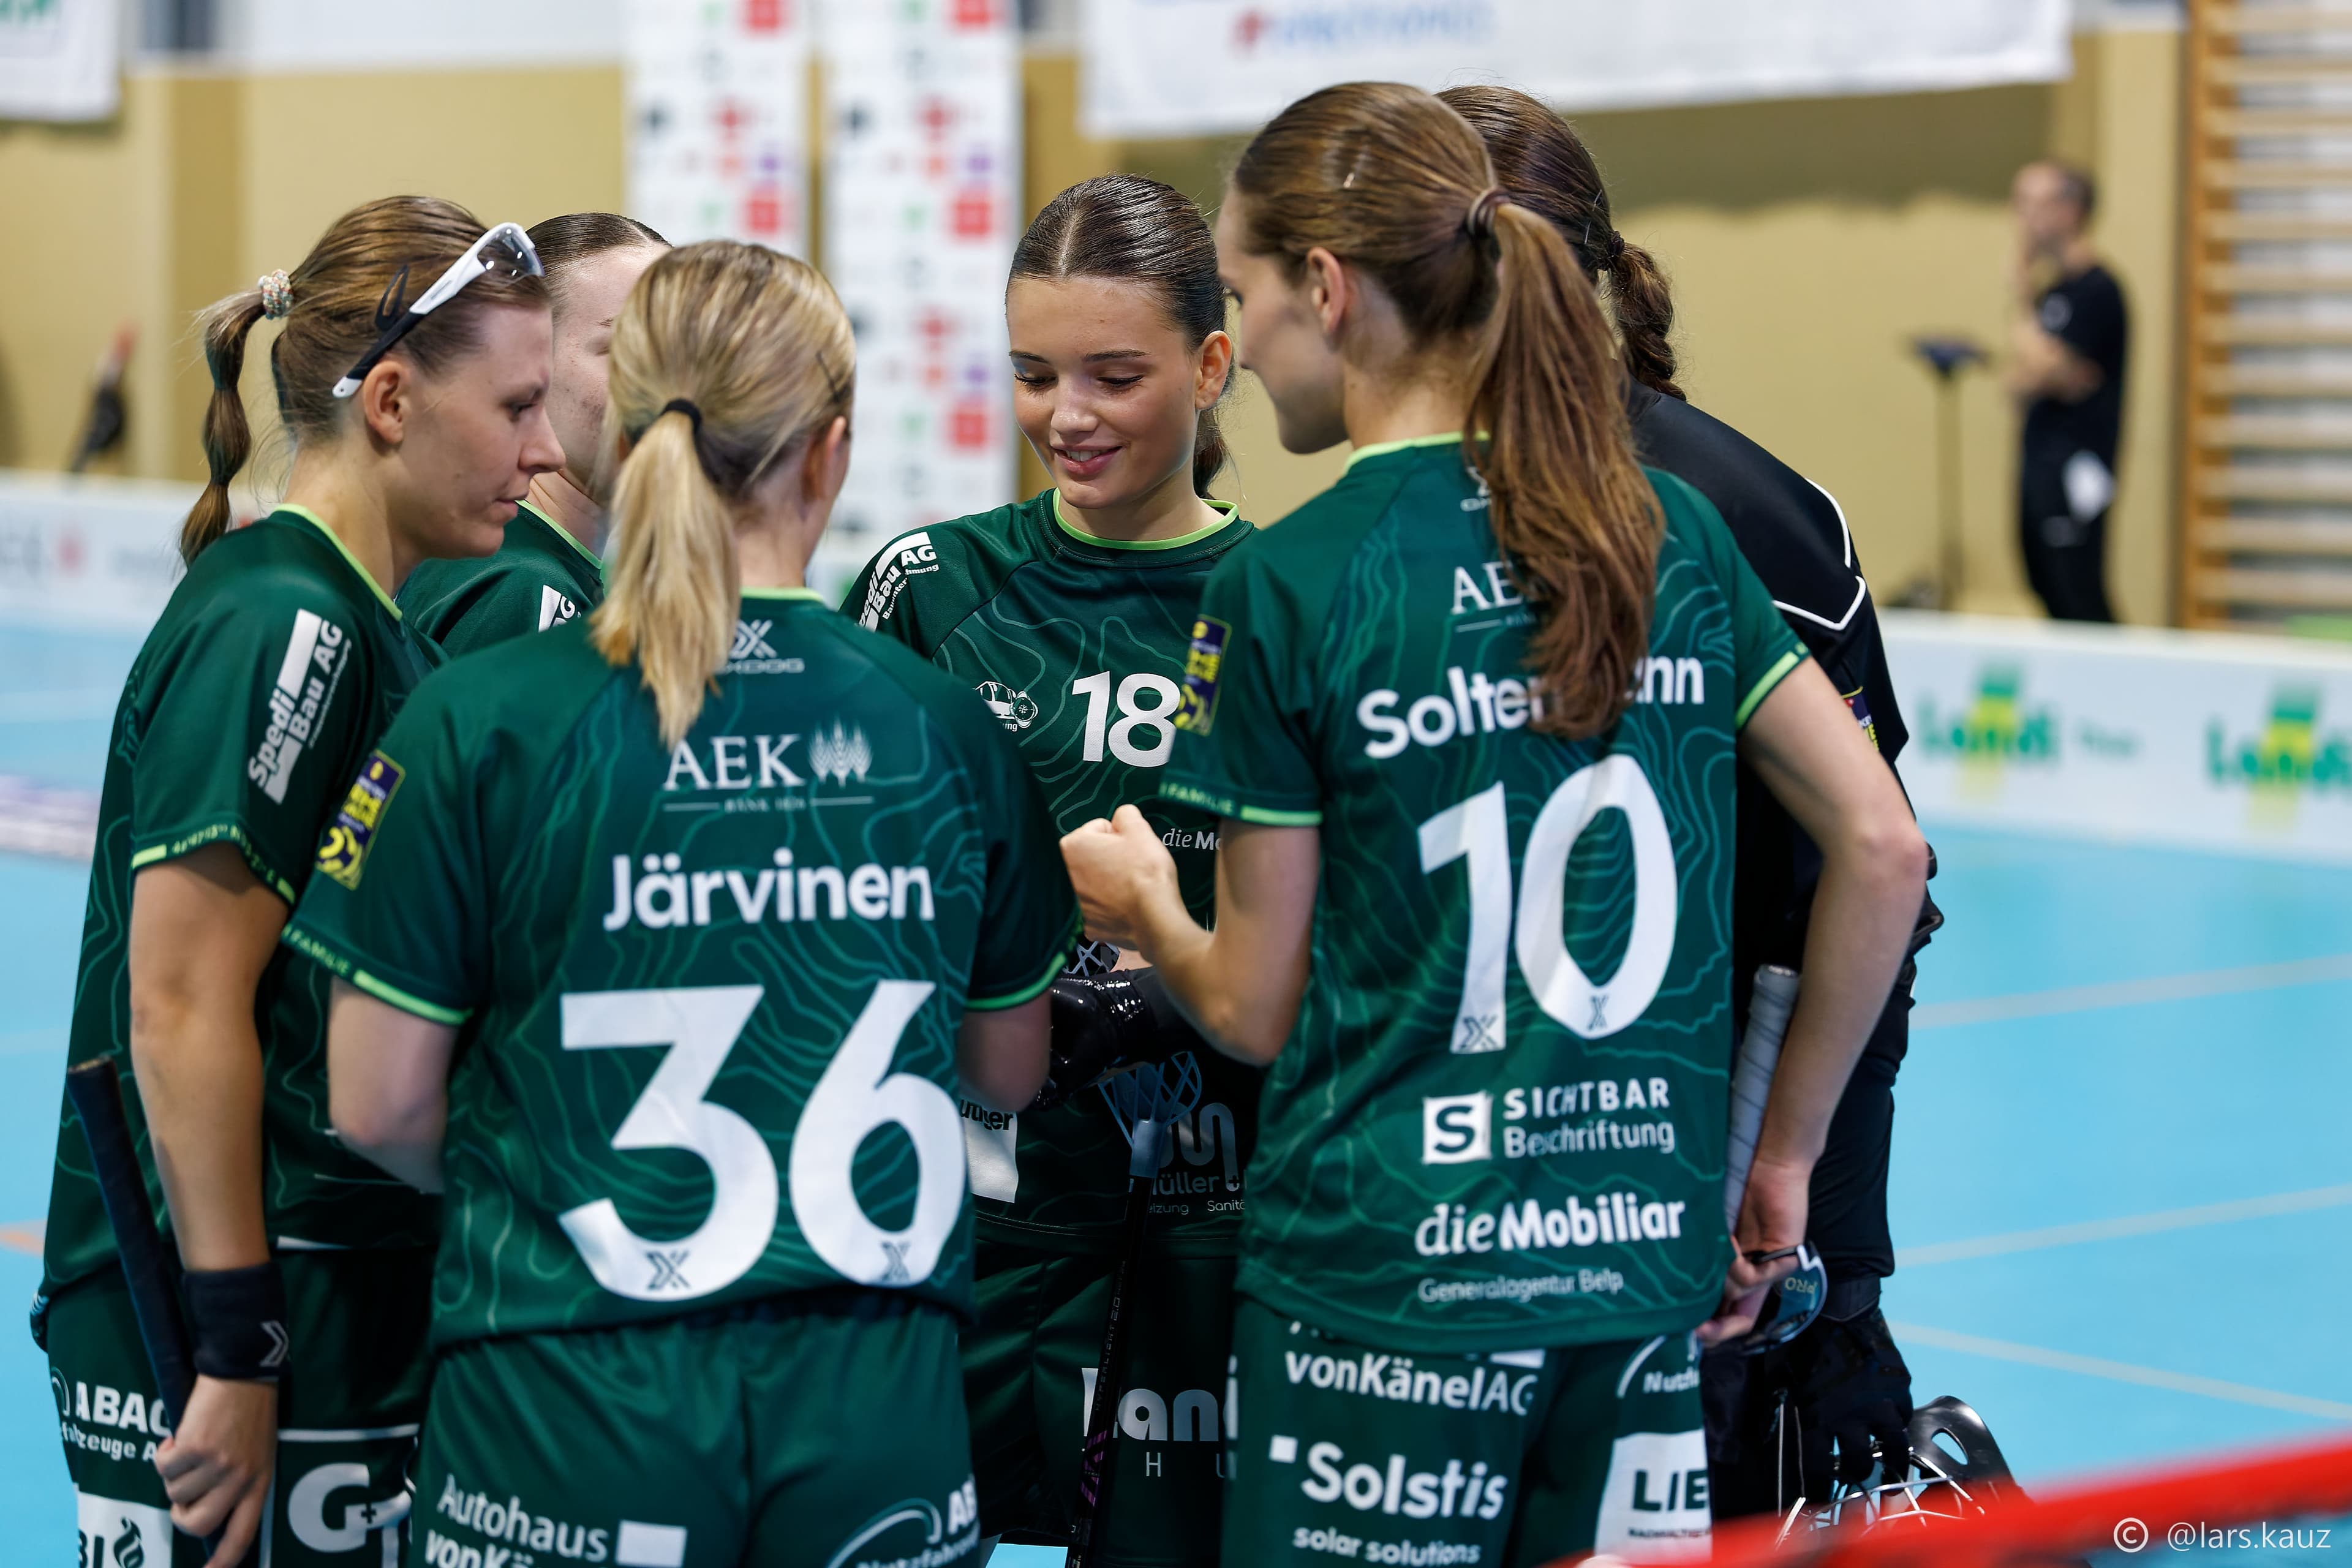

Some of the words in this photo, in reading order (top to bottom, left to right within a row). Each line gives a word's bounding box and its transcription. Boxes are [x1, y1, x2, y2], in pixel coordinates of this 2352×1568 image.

[856, 571, 879, 627] pedi
[872, 565, 902, 613] Bau
[901, 545, 937, 567] AG
[1450, 560, 1525, 614] AE
[288, 676, 326, 744] Bau
[312, 619, 343, 675] AG
[1071, 671, 1181, 767] 18
[248, 687, 295, 790] Spedi
[662, 733, 807, 791] AEK
[603, 847, 935, 932] Järvinen
[1417, 753, 1678, 1054] 10
[1502, 1077, 1670, 1121] SICHTBAR
[558, 978, 967, 1302] 36
[1417, 1275, 1575, 1303] Generalagentur
[1578, 1268, 1624, 1297] Belp
[436, 1472, 609, 1563] Autohaus
[1300, 1441, 1509, 1520] Solstis
[1292, 1526, 1363, 1558] solar
[1365, 1539, 1482, 1567] solutions
